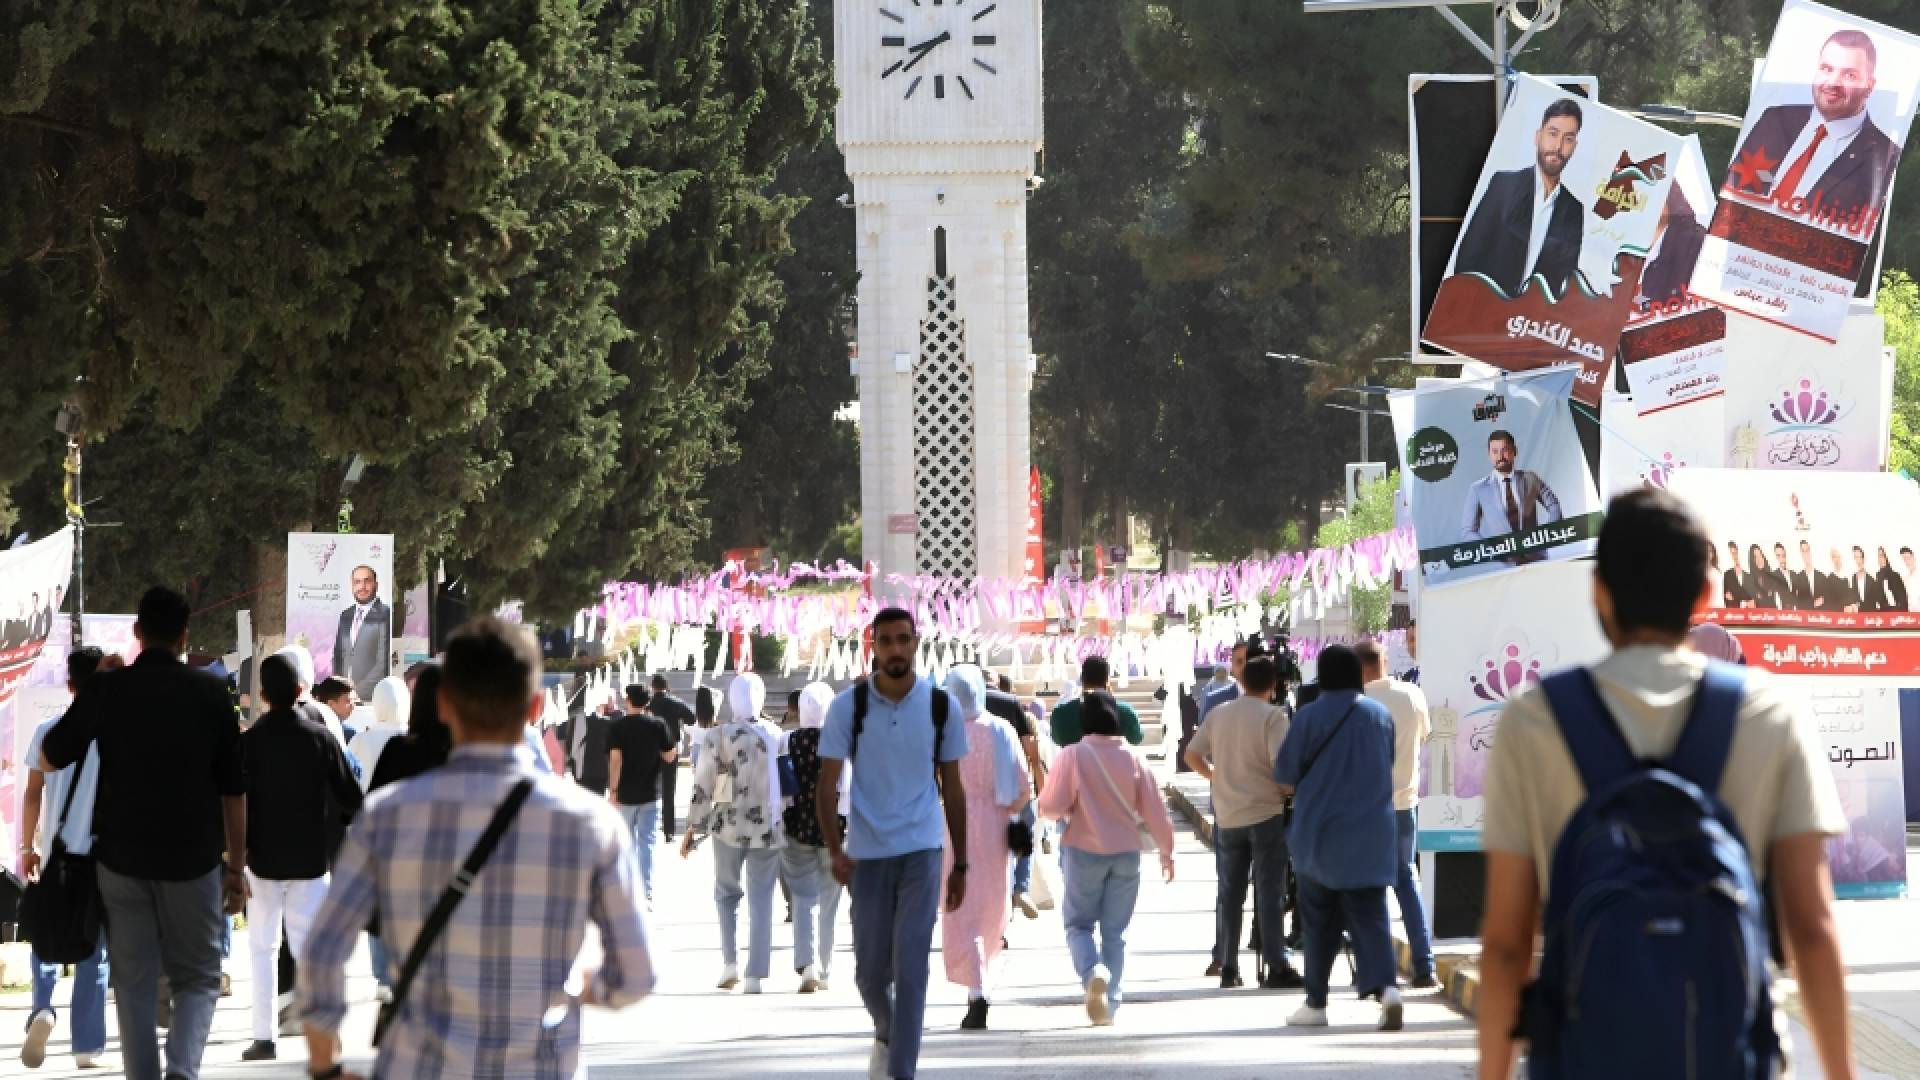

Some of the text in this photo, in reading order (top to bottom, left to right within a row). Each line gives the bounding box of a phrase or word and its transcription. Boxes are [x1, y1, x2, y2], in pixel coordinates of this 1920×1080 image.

[1506, 315, 1573, 348] الكندري
[1568, 337, 1605, 362] حمد
[1453, 525, 1578, 563] عبدالله العجارمة
[1828, 741, 1896, 769] الصوت
